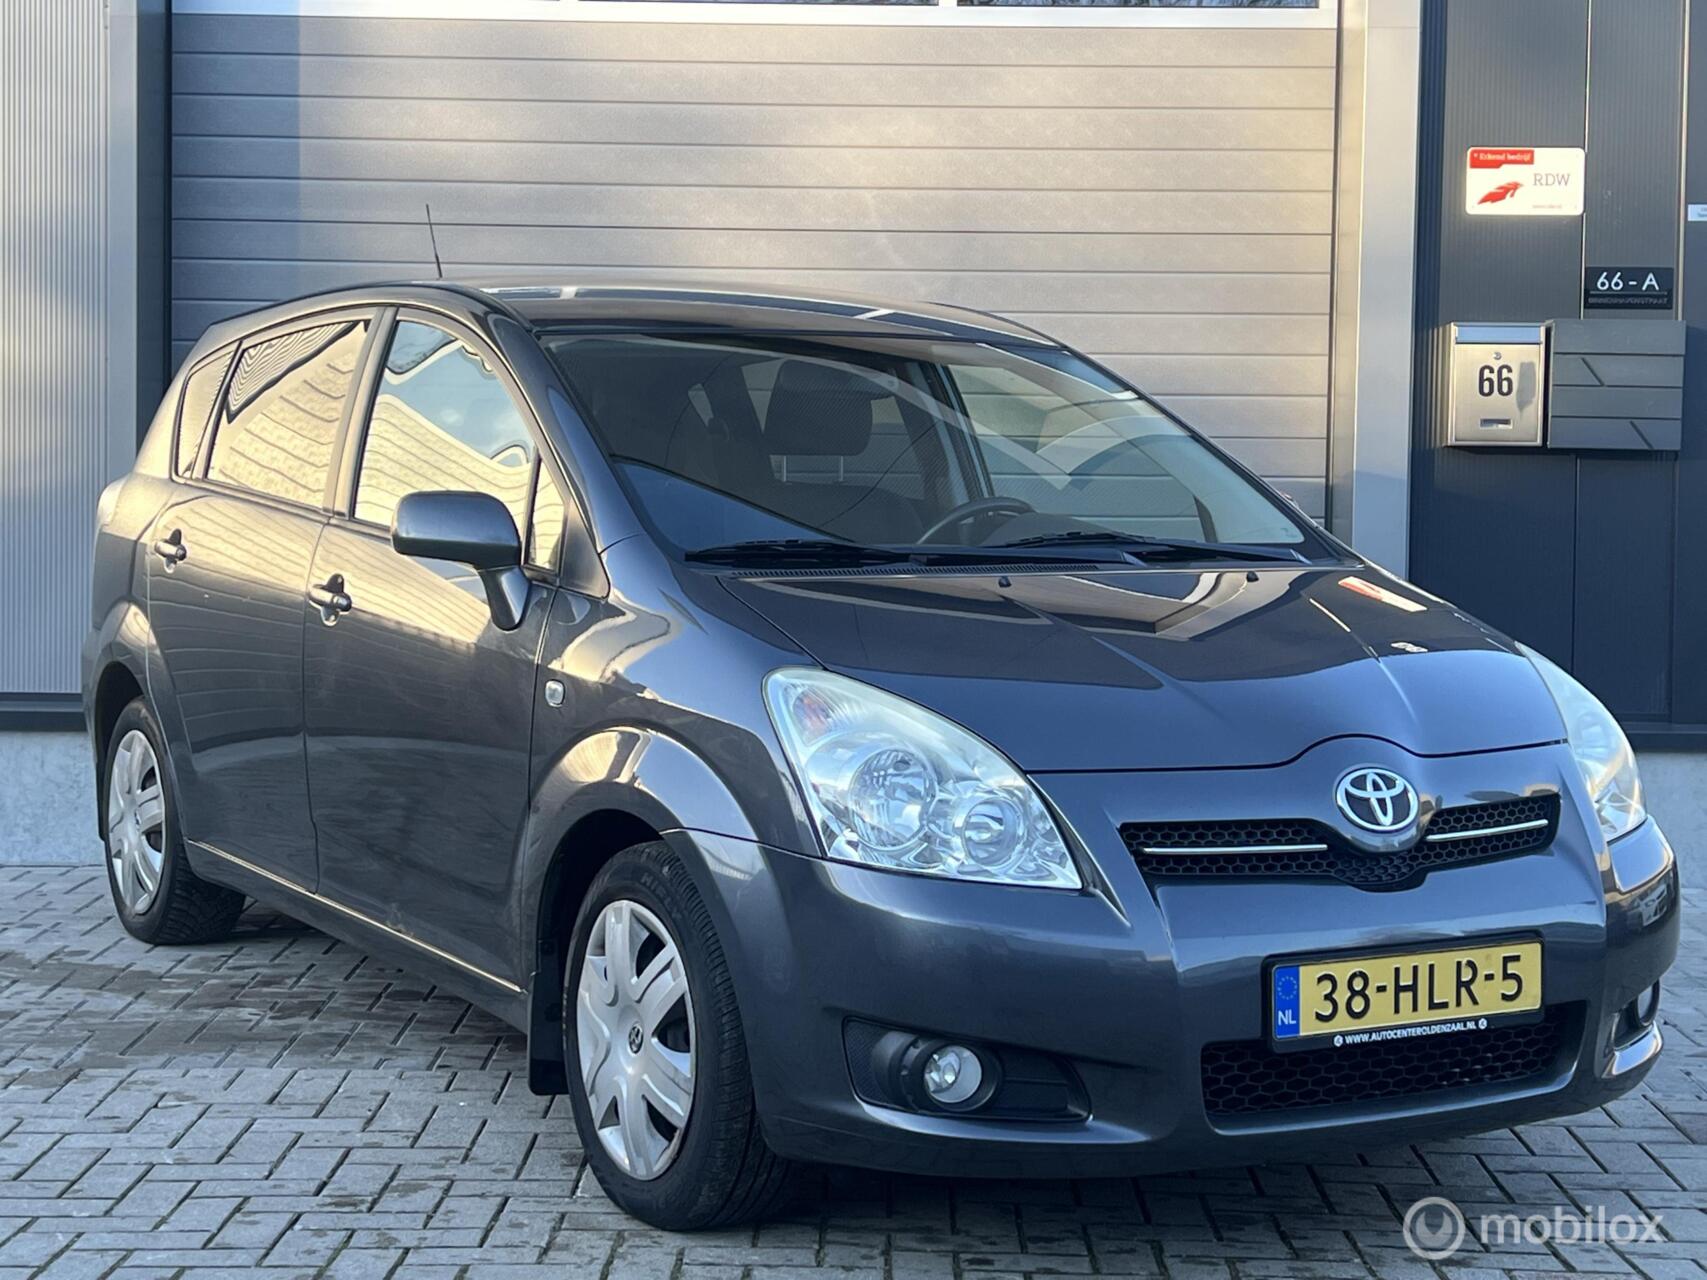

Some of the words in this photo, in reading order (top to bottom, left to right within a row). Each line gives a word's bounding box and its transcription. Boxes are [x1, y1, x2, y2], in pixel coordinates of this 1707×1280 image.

[1533, 173, 1571, 187] RDW
[1478, 364, 1514, 397] 66
[1314, 954, 1523, 1023] 38-HLR-5
[1277, 1010, 1297, 1026] NL
[1344, 1020, 1477, 1045] WWW.AUTOCENTEROLDENZAAL.NL
